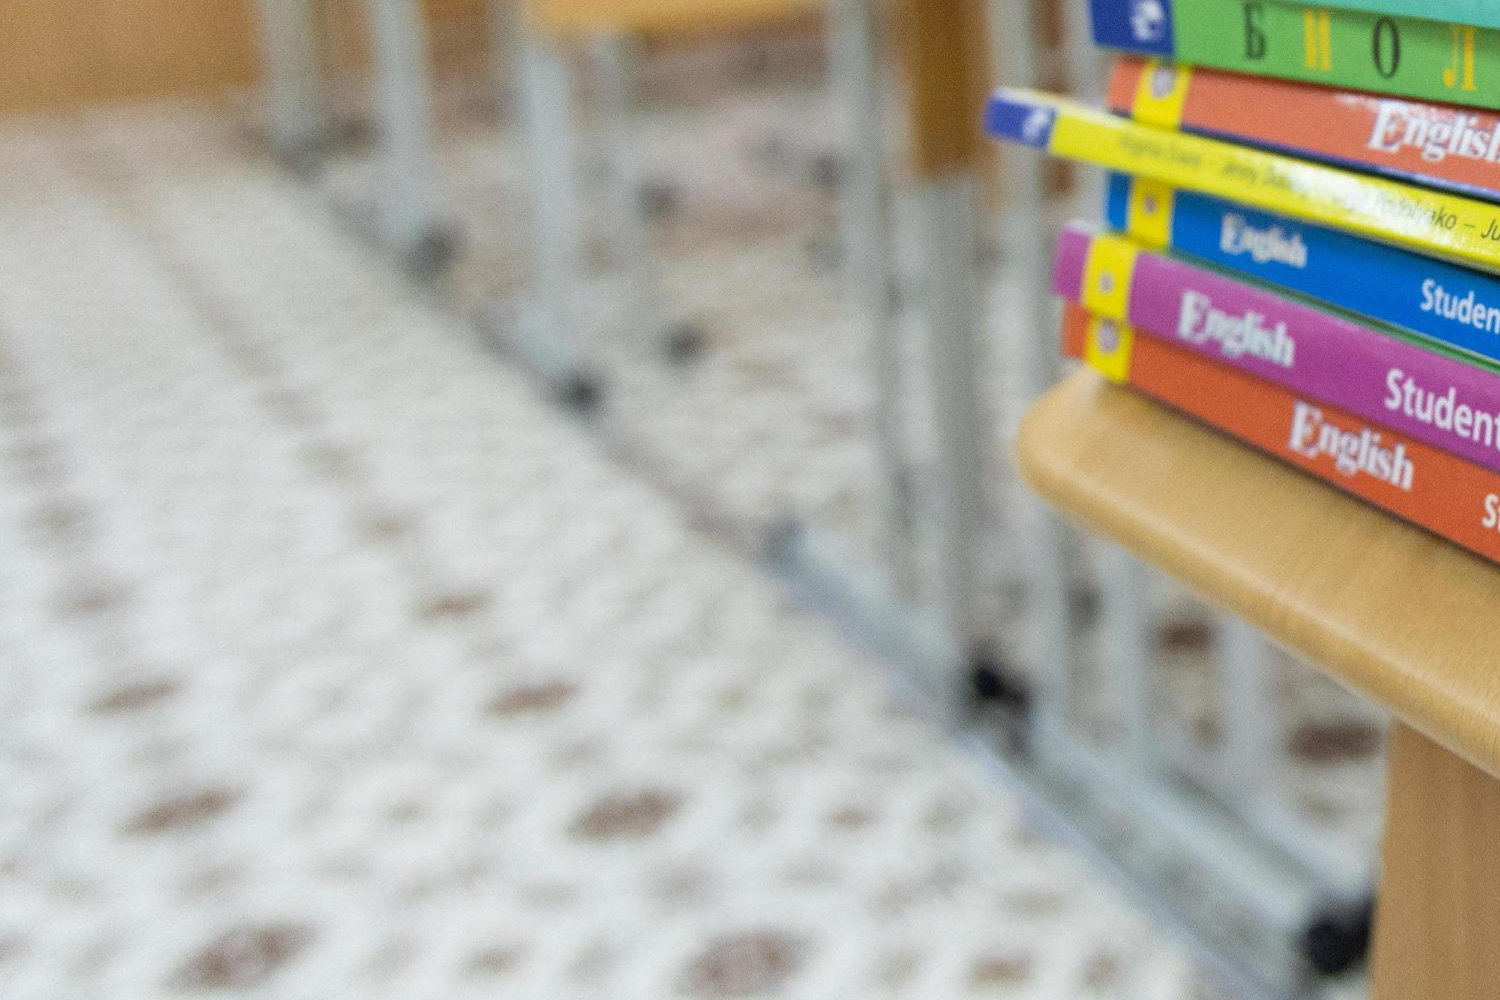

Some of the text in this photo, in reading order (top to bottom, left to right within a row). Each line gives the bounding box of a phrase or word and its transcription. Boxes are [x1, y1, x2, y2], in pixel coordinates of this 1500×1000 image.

[1220, 212, 1308, 268] English
[1178, 290, 1297, 369] English
[1288, 398, 1415, 491] English
